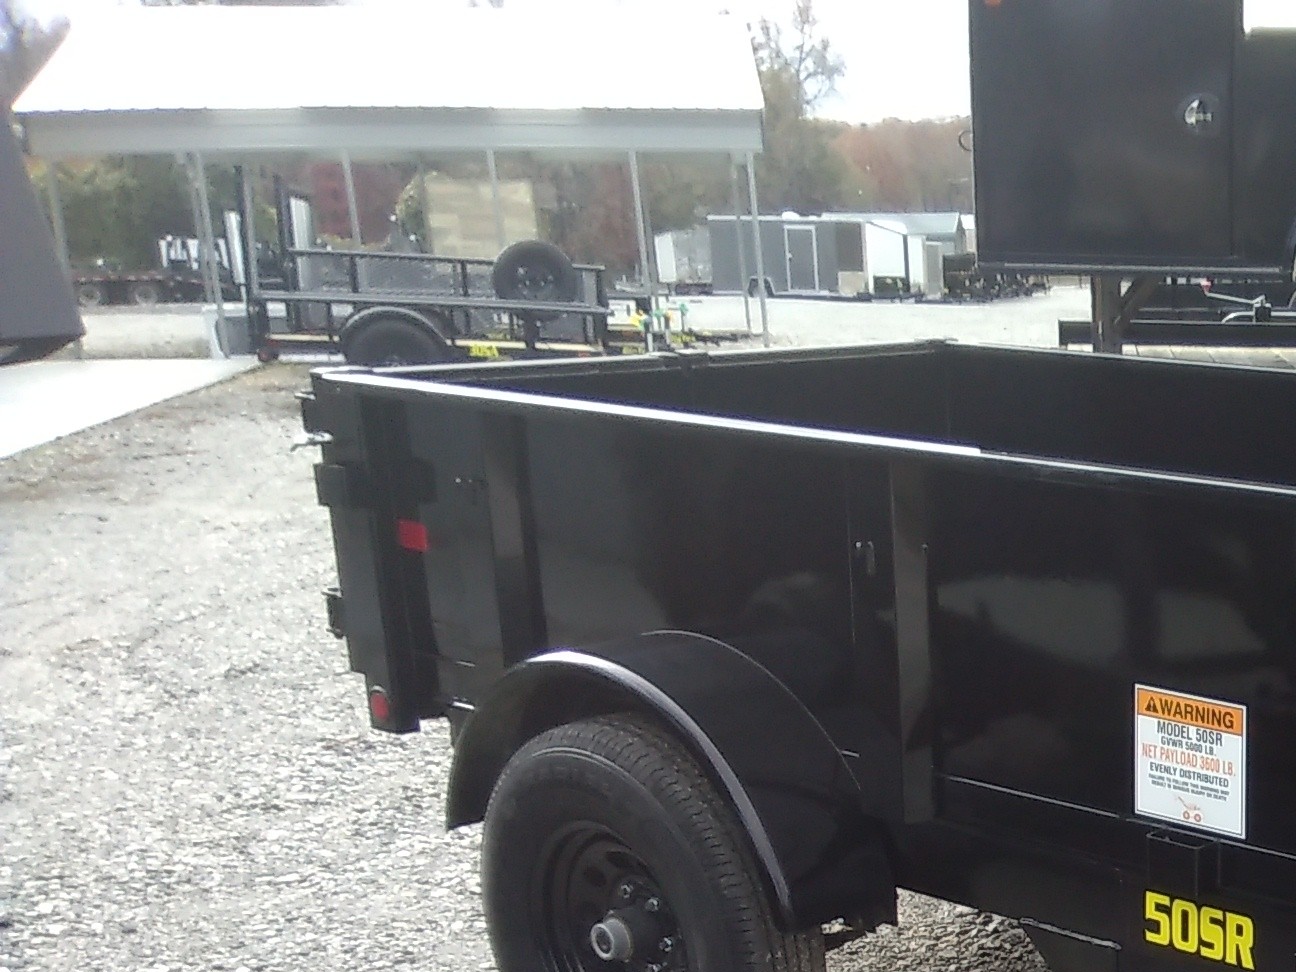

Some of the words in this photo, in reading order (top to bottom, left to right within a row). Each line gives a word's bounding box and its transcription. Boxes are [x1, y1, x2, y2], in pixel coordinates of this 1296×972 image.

[1159, 698, 1234, 730] WARNING
[1157, 720, 1192, 740] MODEL
[1195, 728, 1223, 747] 50SR
[1161, 736, 1183, 749] GVWR
[1142, 742, 1157, 759] NET
[1160, 746, 1198, 768] PAYLOAD
[1150, 762, 1177, 776] EVENLY
[1179, 768, 1229, 788] DISTRIBUTED
[1144, 890, 1256, 971] 50SR
